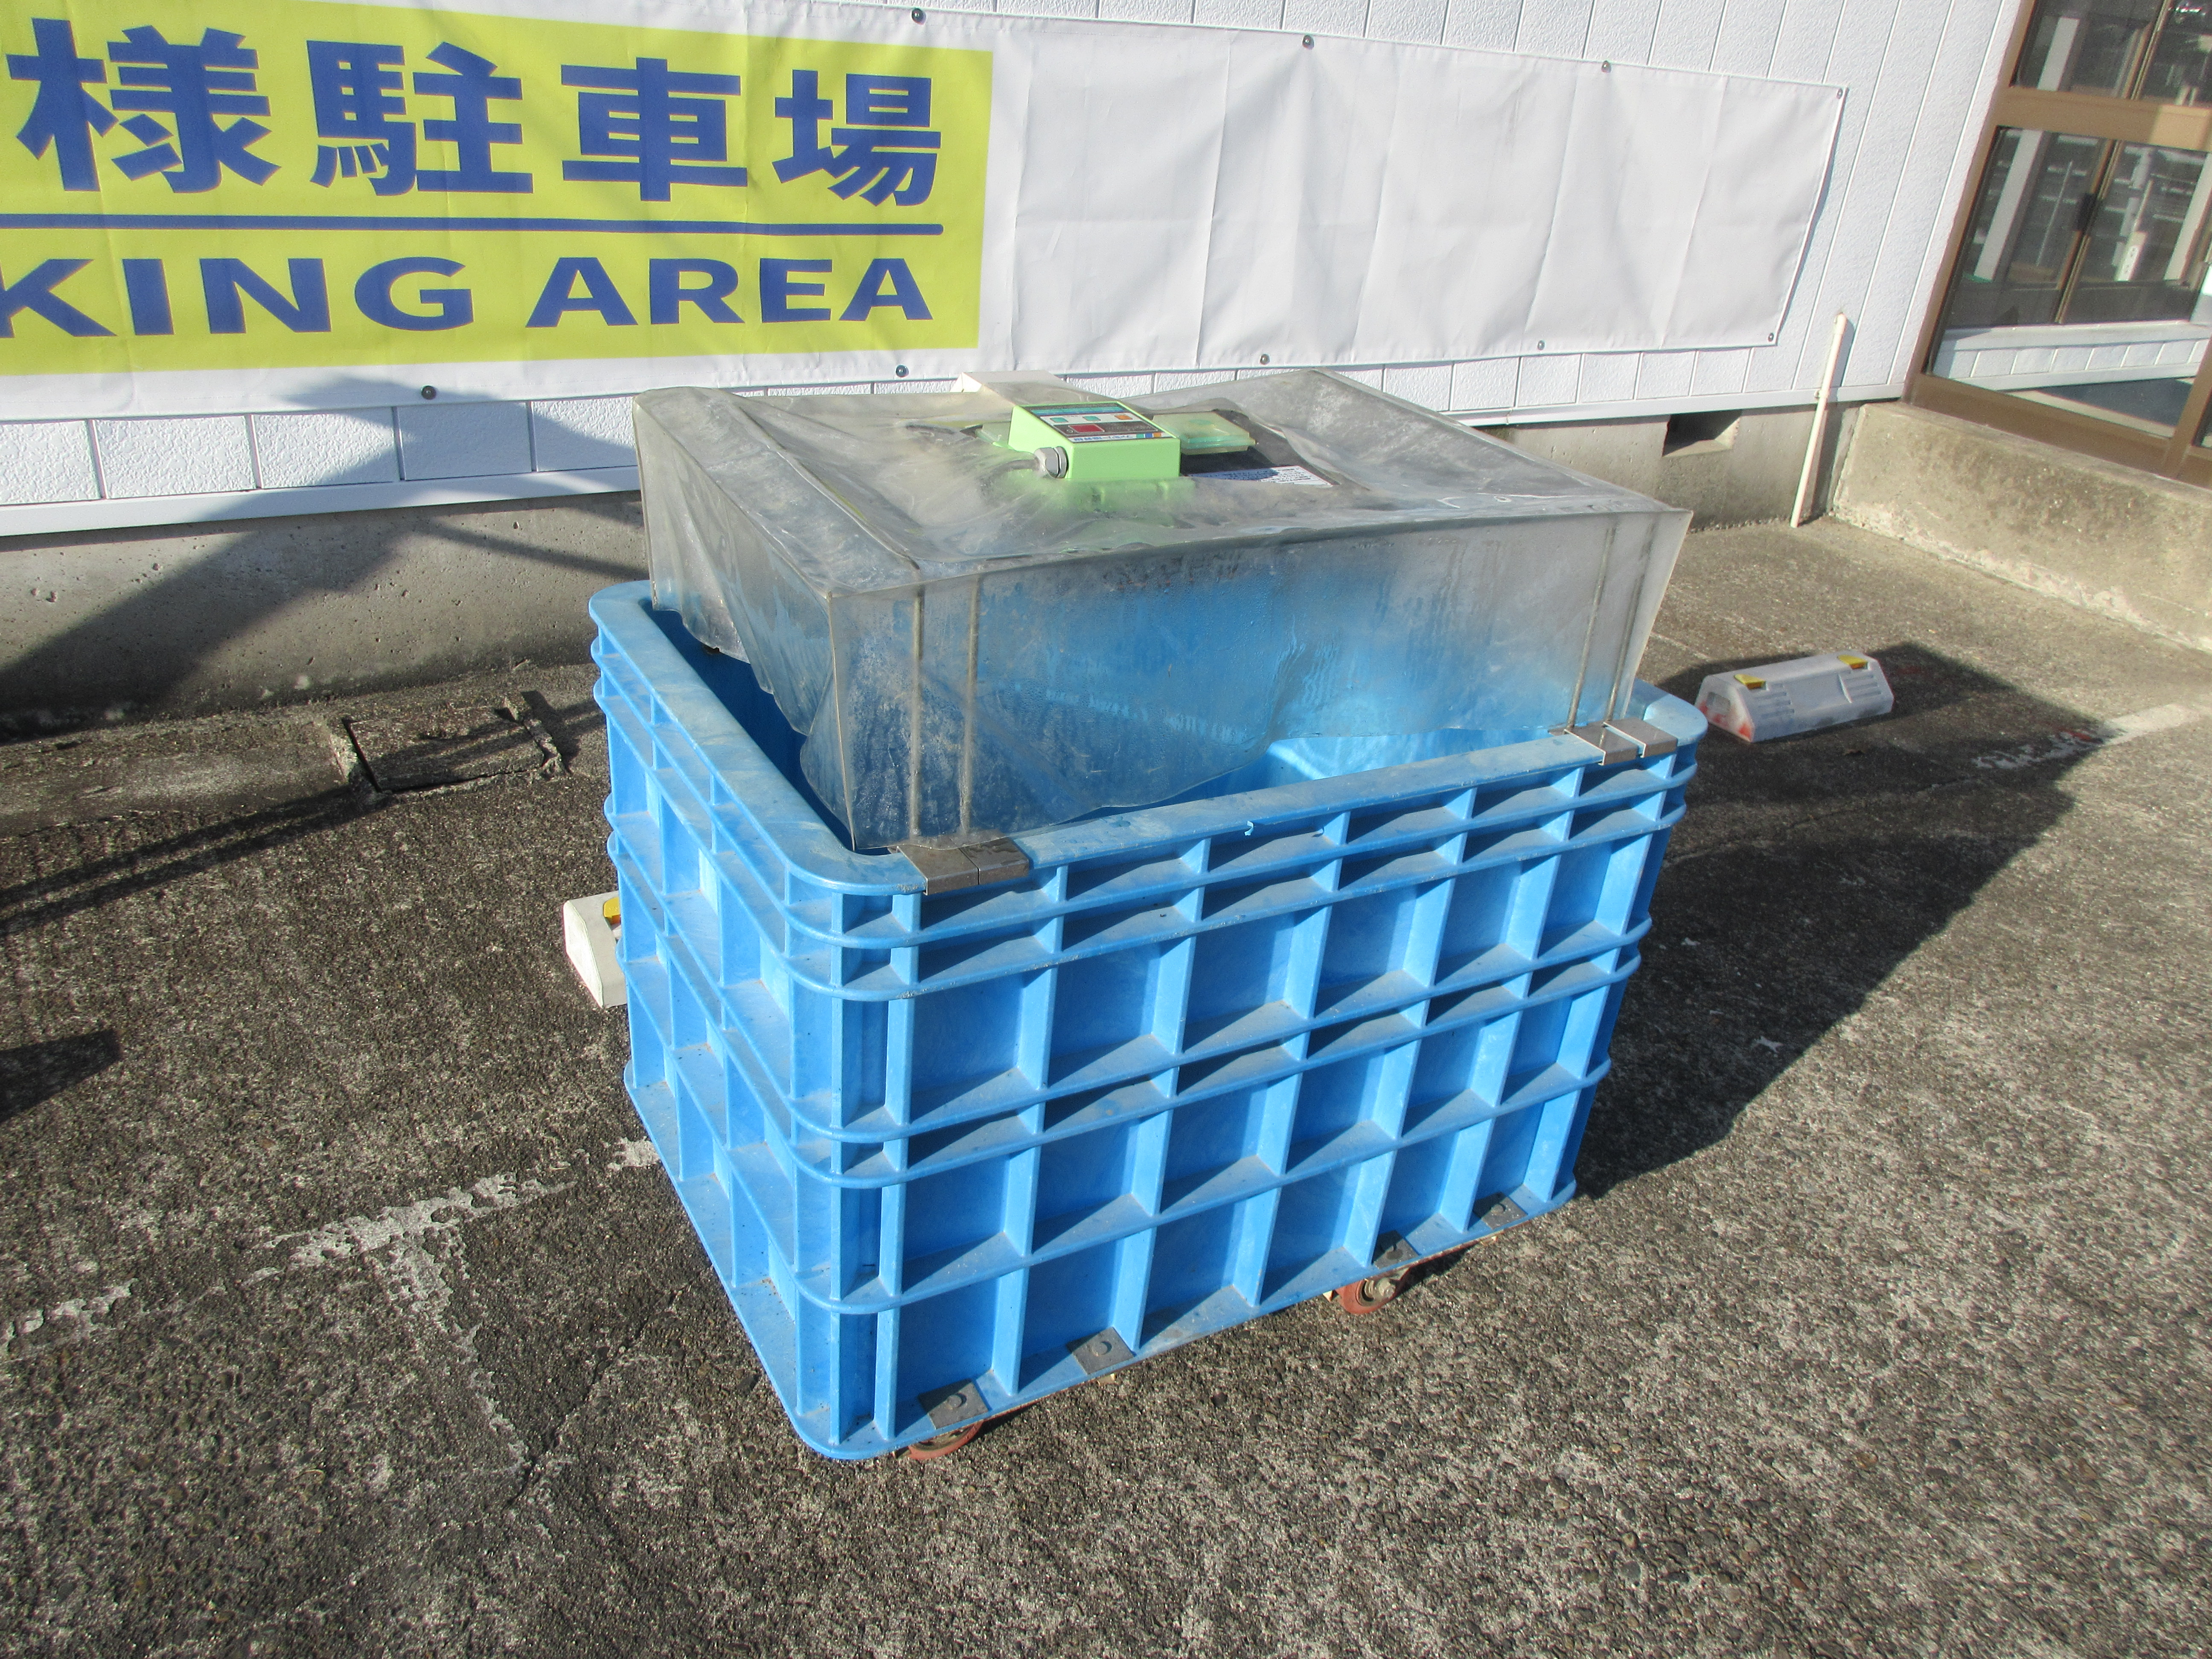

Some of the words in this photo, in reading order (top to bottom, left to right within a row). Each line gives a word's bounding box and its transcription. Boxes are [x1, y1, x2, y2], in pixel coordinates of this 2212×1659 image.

[6, 18, 942, 206] 様駐車場
[525, 257, 933, 327] AREA
